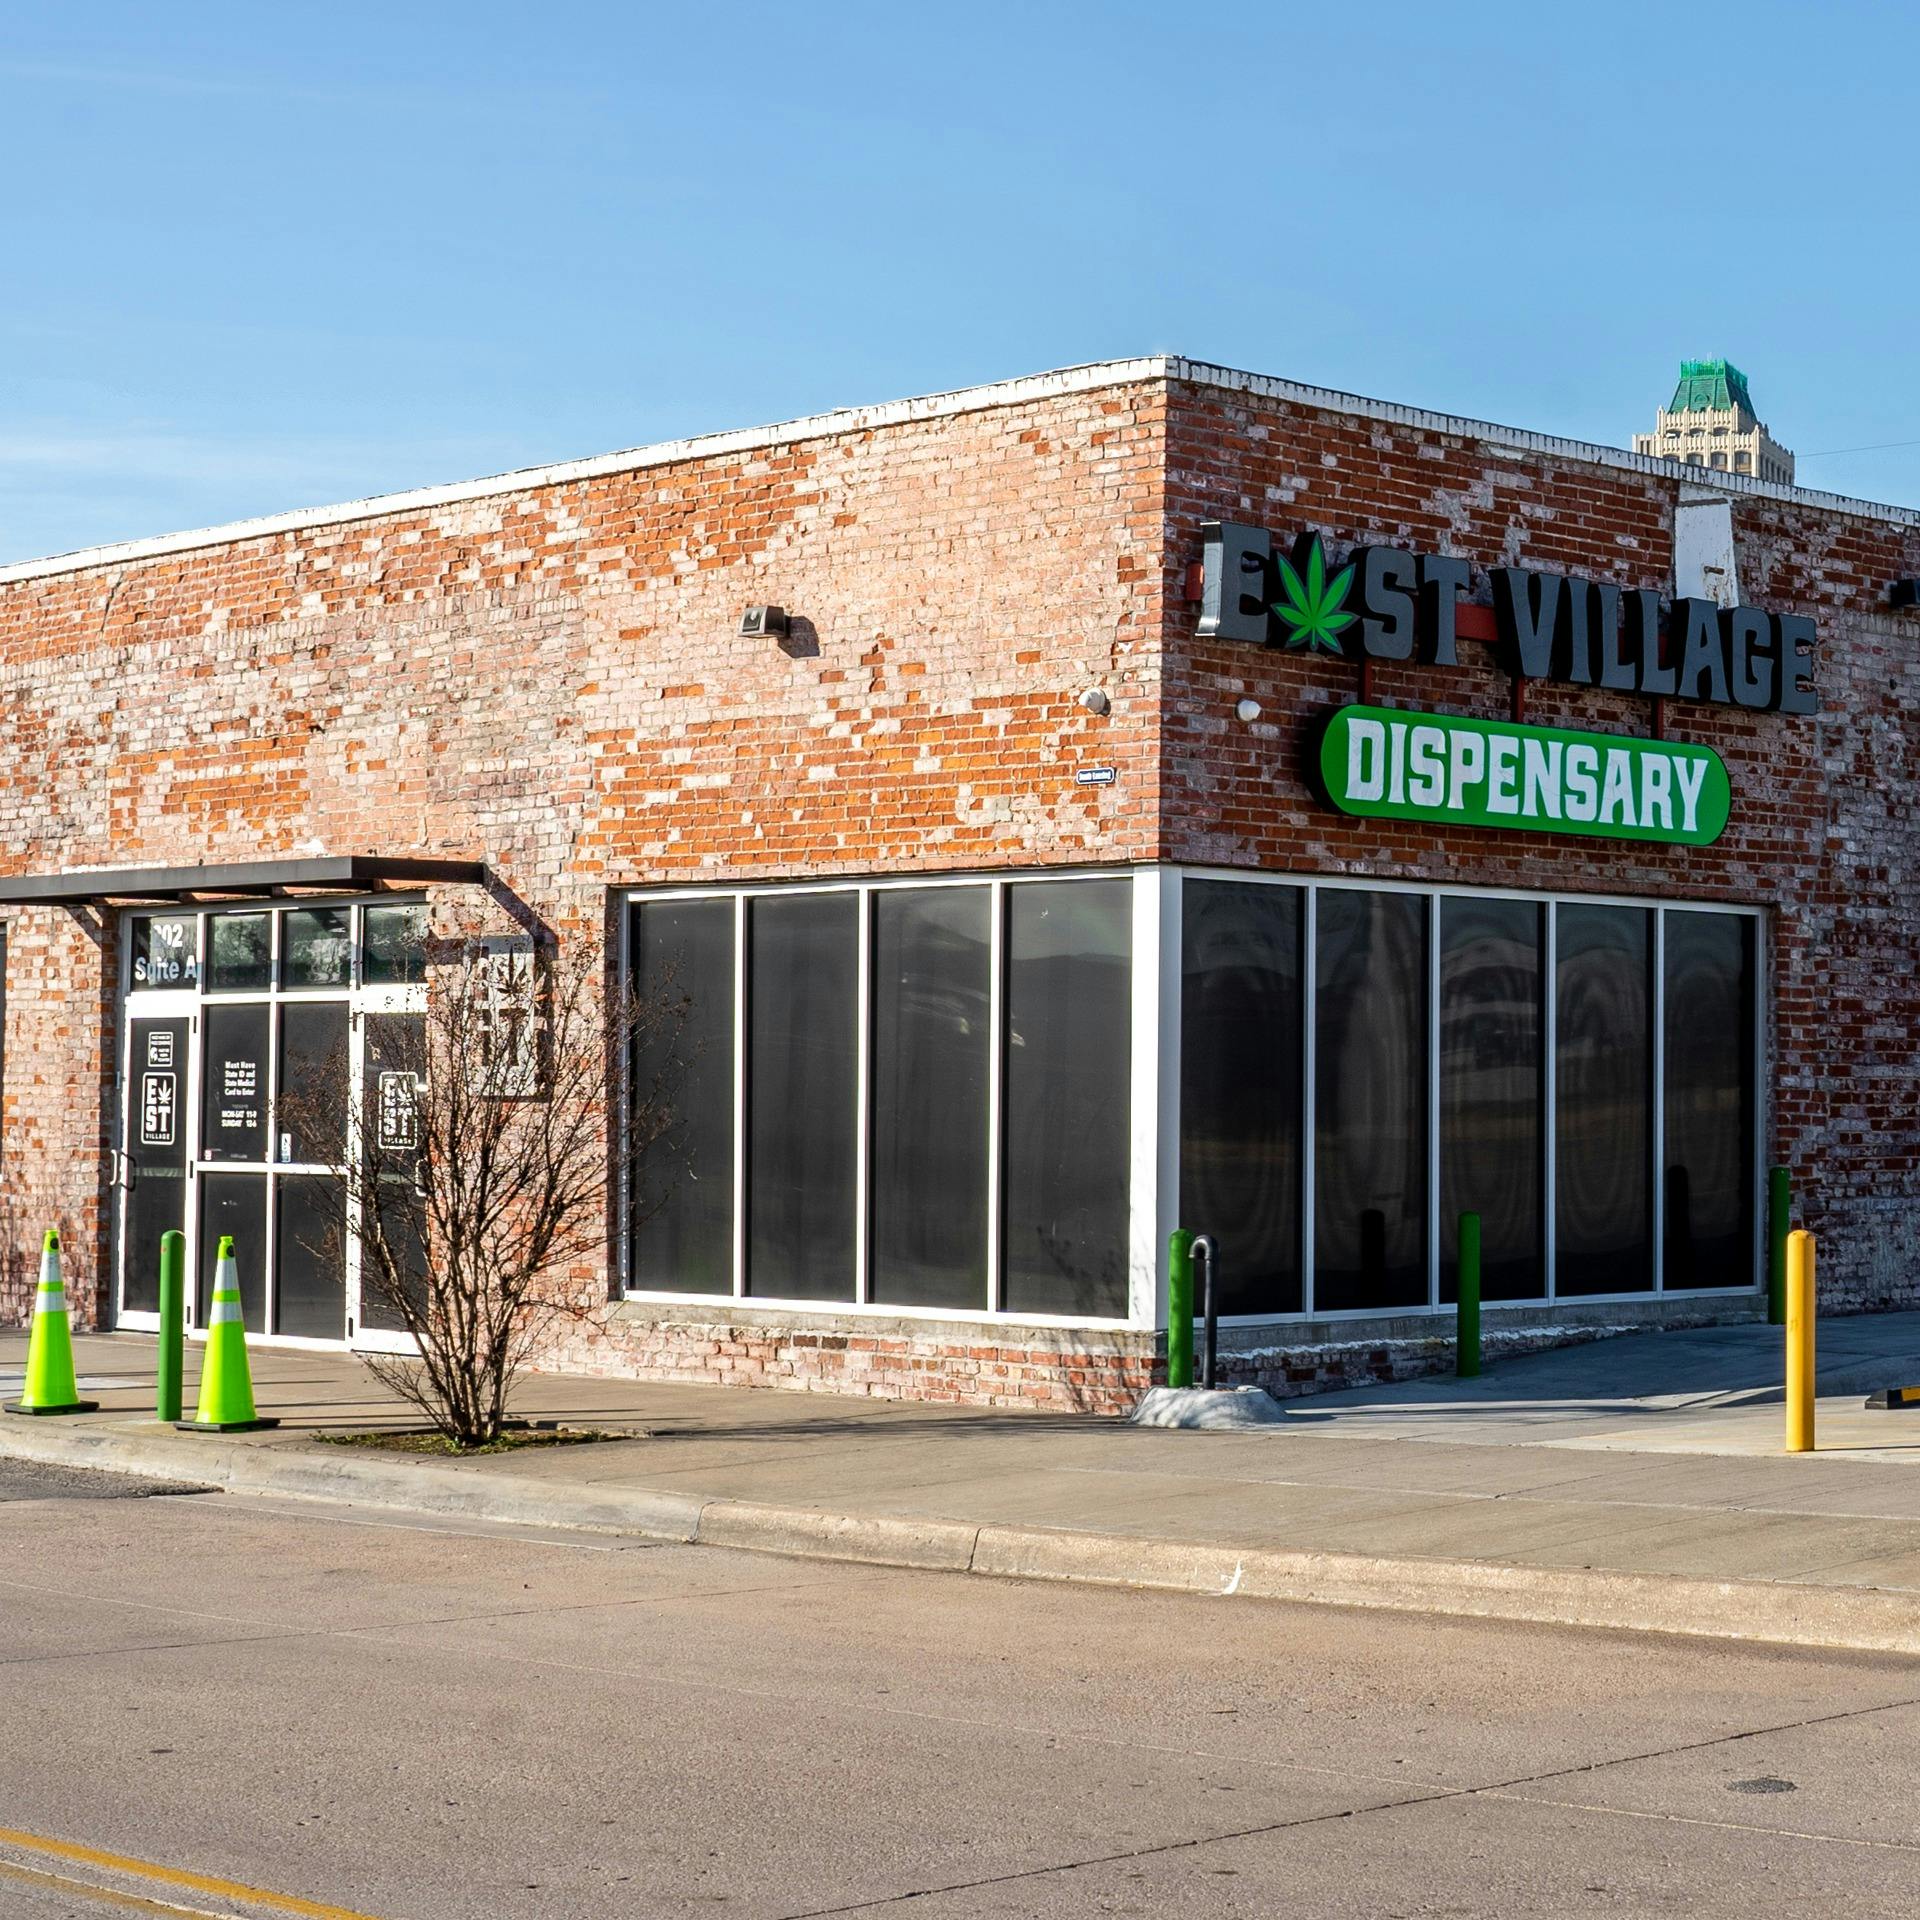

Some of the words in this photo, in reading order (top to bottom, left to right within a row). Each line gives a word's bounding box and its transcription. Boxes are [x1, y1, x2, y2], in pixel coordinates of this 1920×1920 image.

[1490, 567, 1818, 716] VILLAGE
[1345, 717, 1709, 832] DISPENSARY
[135, 956, 180, 981] Suite
[184, 954, 197, 979] A
